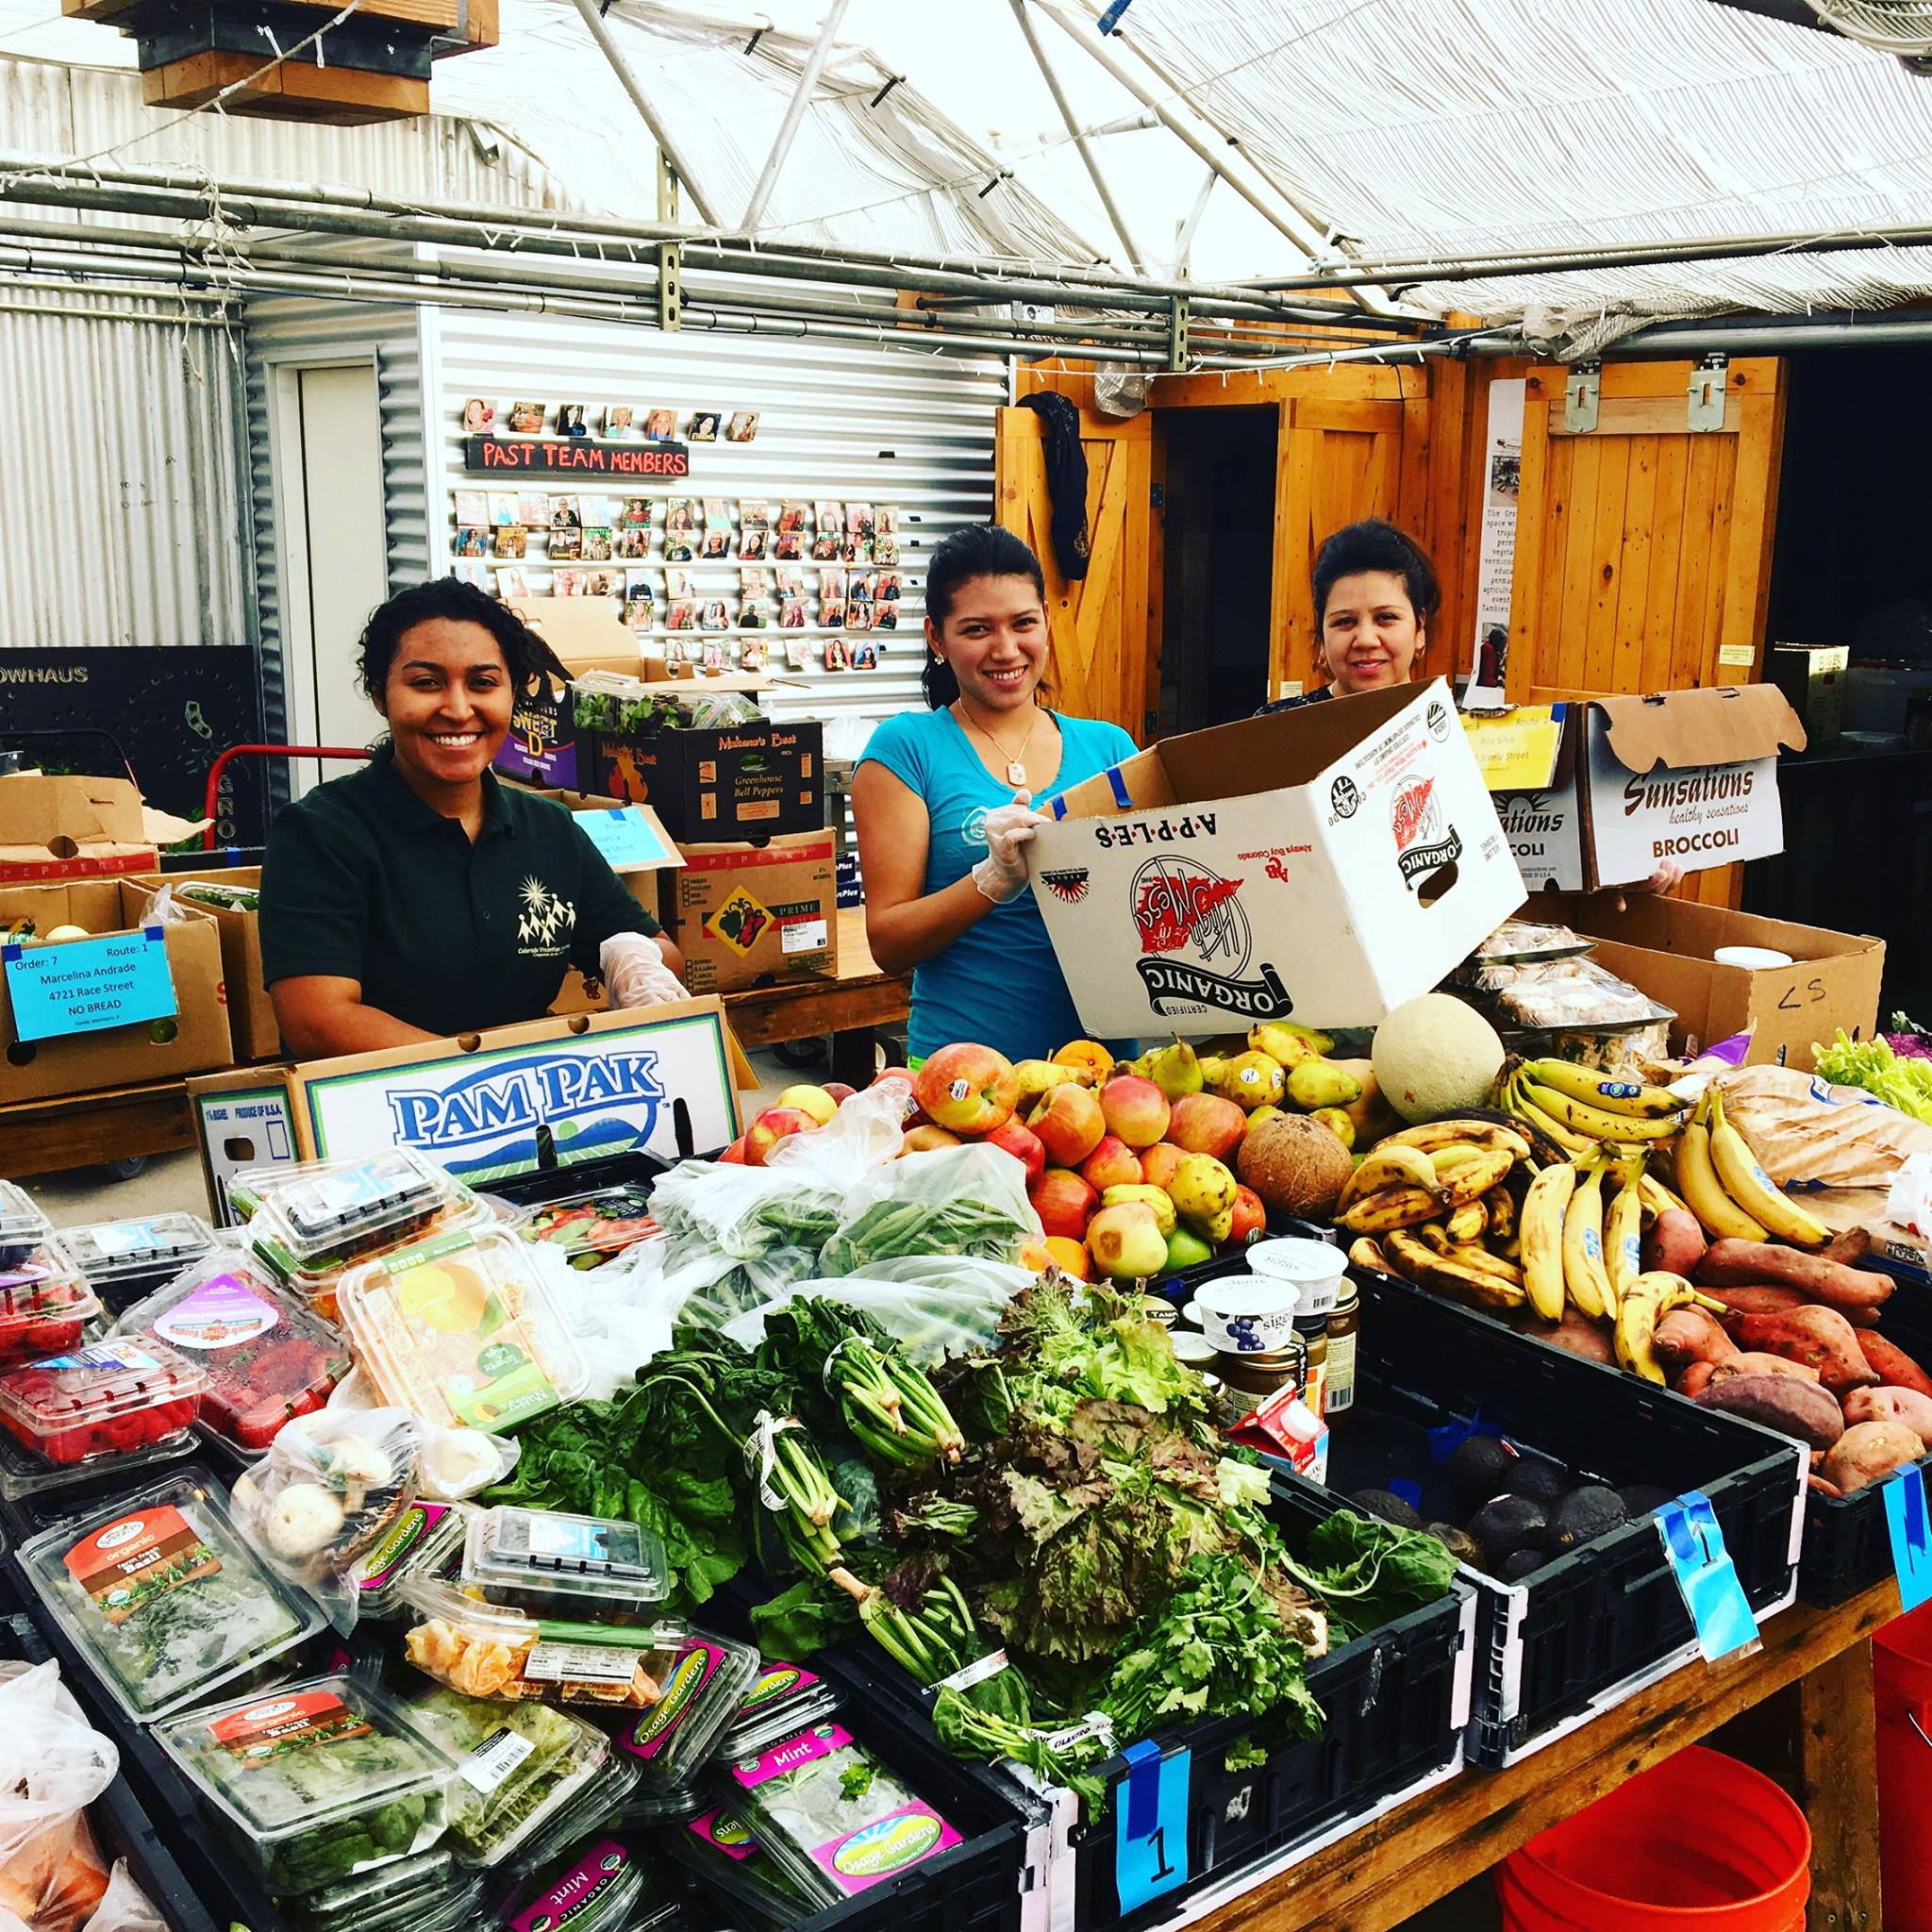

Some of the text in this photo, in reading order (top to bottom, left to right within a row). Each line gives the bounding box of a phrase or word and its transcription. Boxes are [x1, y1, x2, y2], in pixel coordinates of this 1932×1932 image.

[483, 441, 688, 475] PAST TEAM MEMBERS
[1506, 751, 1529, 760] Street
[734, 786, 784, 798] Bell Peppers
[735, 774, 783, 786] Greenhouse
[1624, 768, 1754, 817] Sunsations
[1669, 802, 1750, 825] healthy sensations
[1238, 844, 1312, 860] Always Buy Colorado
[1653, 828, 1740, 858] BROCCOLI
[1402, 843, 1457, 874] ORGANIC
[779, 903, 816, 916] PRIME
[15, 943, 148, 972] Order: 7 Route: 1
[41, 962, 136, 985] Marcelina Andrade
[49, 980, 134, 1001] 4721 Race Street
[1145, 968, 1274, 1012] ORGANIC
[68, 999, 122, 1016] NO BREAD
[1166, 1004, 1208, 1016] CERTIFIED
[387, 1074, 537, 1145] PAM
[538, 1051, 664, 1118] PAK
[386, 1512, 424, 1554] Gardens
[106, 1534, 156, 1561] organic
[117, 1546, 160, 1570] farm fresh
[123, 1551, 162, 1574] Basil
[640, 1655, 706, 1744] Osage Gardens
[252, 1709, 307, 1728] organic
[268, 1721, 310, 1738] Basil
[774, 1742, 812, 1767] Mint
[841, 1850, 886, 1874] Osage
[884, 1824, 937, 1855] Gardens
[1147, 1825, 1174, 1883] 1
[550, 1872, 590, 1906] Mint
[560, 1877, 608, 1921] ORGANIC
